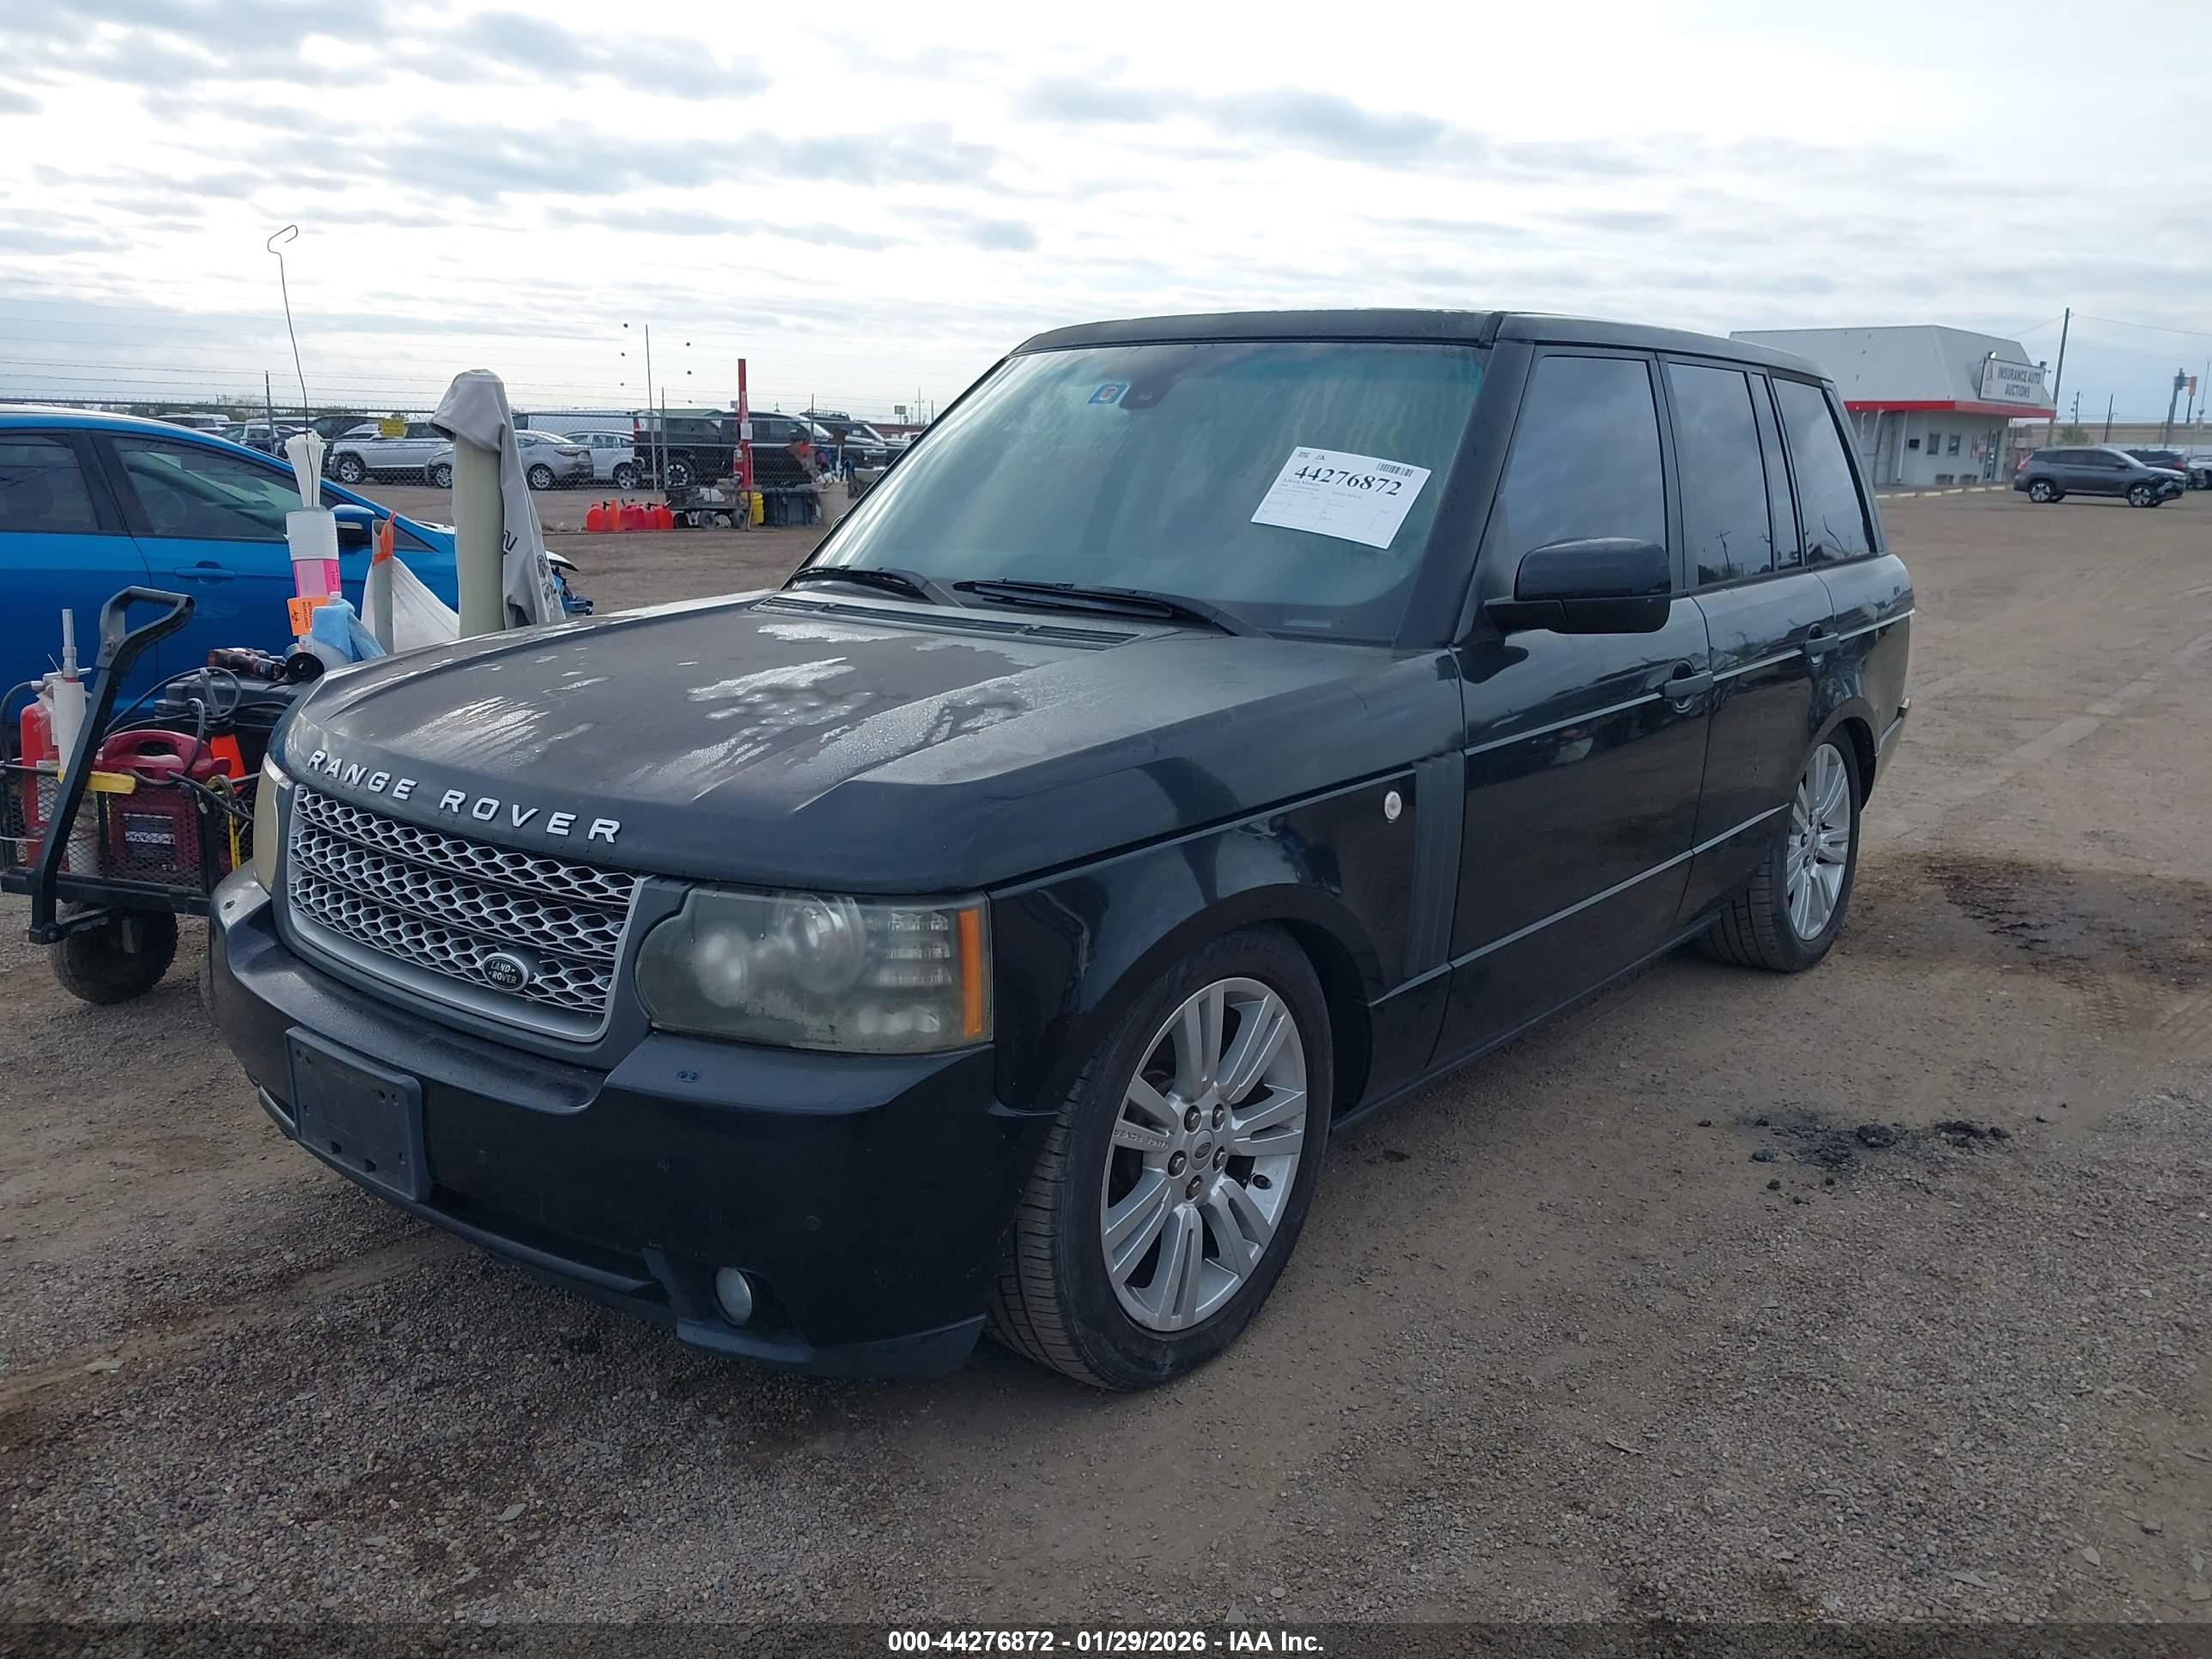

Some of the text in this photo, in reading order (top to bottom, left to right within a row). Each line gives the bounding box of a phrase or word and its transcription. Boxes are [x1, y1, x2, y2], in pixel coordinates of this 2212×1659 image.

[1998, 367, 2027, 383] INSURANCE
[2027, 371, 2041, 385] AUTO
[2005, 384, 2031, 398] AUCTIONS
[1294, 465, 1402, 496] 44276872
[307, 749, 622, 844] RANGE ROVER
[490, 960, 511, 973] LAND
[491, 971, 517, 984] ROVER
